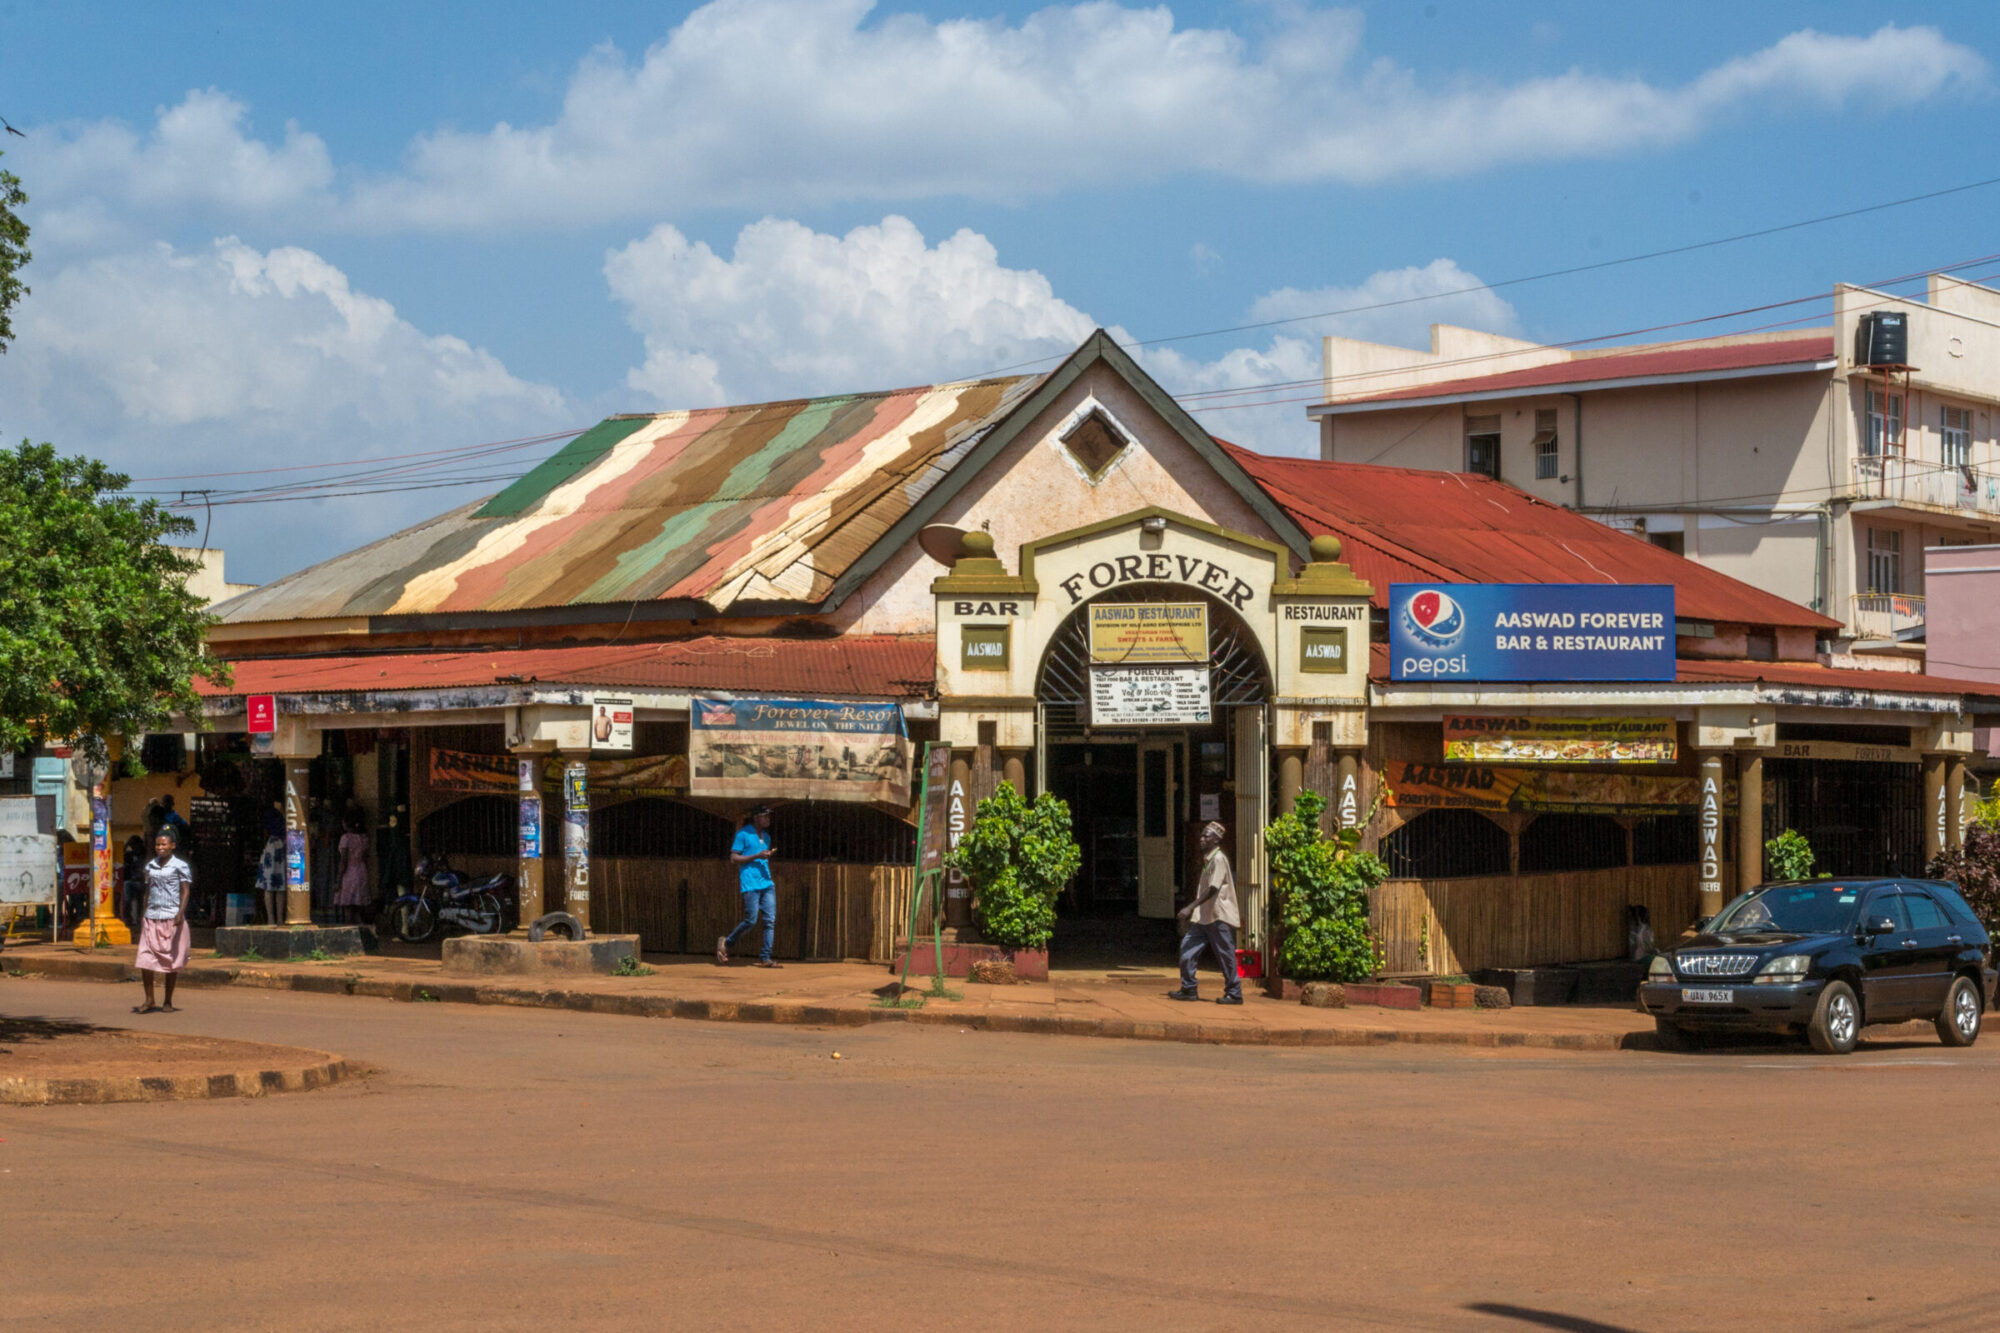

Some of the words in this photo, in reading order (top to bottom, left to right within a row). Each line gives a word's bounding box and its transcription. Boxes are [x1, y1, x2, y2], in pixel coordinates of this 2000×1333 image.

[1059, 553, 1254, 611] FOREVER
[954, 601, 1019, 616] BAR
[1094, 607, 1135, 620] AASWAD
[1138, 607, 1202, 620] RESTAURANT
[1285, 606, 1364, 620] RESTAURANT
[1495, 612, 1575, 628] AASWAD
[1581, 613, 1663, 629] FOREVER
[967, 642, 1003, 656] AASWAD
[1496, 636, 1531, 650] BAR
[1535, 636, 1548, 650] &
[1553, 636, 1665, 651] RESTAURANT
[1305, 644, 1341, 659] AASWAD
[1128, 667, 1175, 676] FOREVER
[1402, 654, 1467, 678] pepsi
[1121, 689, 1135, 697] Veg
[752, 704, 836, 721] Forever
[840, 706, 897, 722] Resor
[774, 720, 808, 728] JEWEL
[811, 720, 828, 729] ON
[834, 721, 854, 730] THE
[858, 722, 885, 731] NILE
[1448, 718, 1530, 731] AASWAD
[1535, 723, 1588, 732] FOREVER
[1591, 722, 1668, 733] RESTAURANT
[1784, 744, 1810, 757] BAR
[1400, 763, 1496, 790] AASWAD
[949, 779, 965, 884] AASWD
[1702, 777, 1718, 879] AASWAD
[1690, 991, 1705, 1001] UAV
[1708, 992, 1729, 1001] 965X
